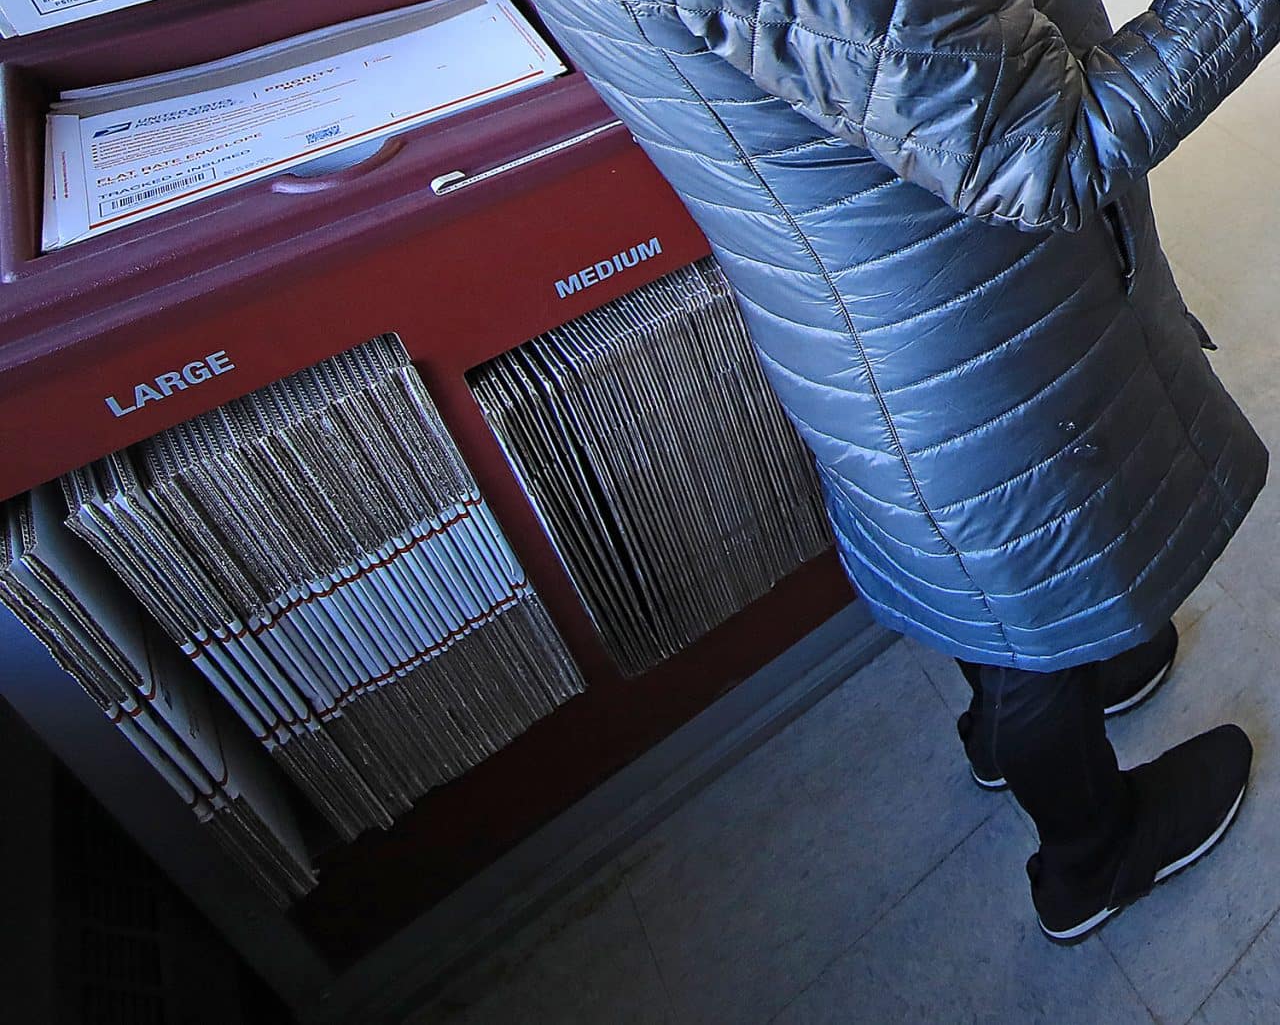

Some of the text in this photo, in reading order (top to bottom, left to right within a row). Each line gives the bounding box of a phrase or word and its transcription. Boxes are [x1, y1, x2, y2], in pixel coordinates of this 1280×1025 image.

[98, 174, 172, 200] TRACKED
[187, 149, 251, 173] INSURED
[554, 236, 663, 299] MEDIUM
[104, 350, 236, 418] LARGE
